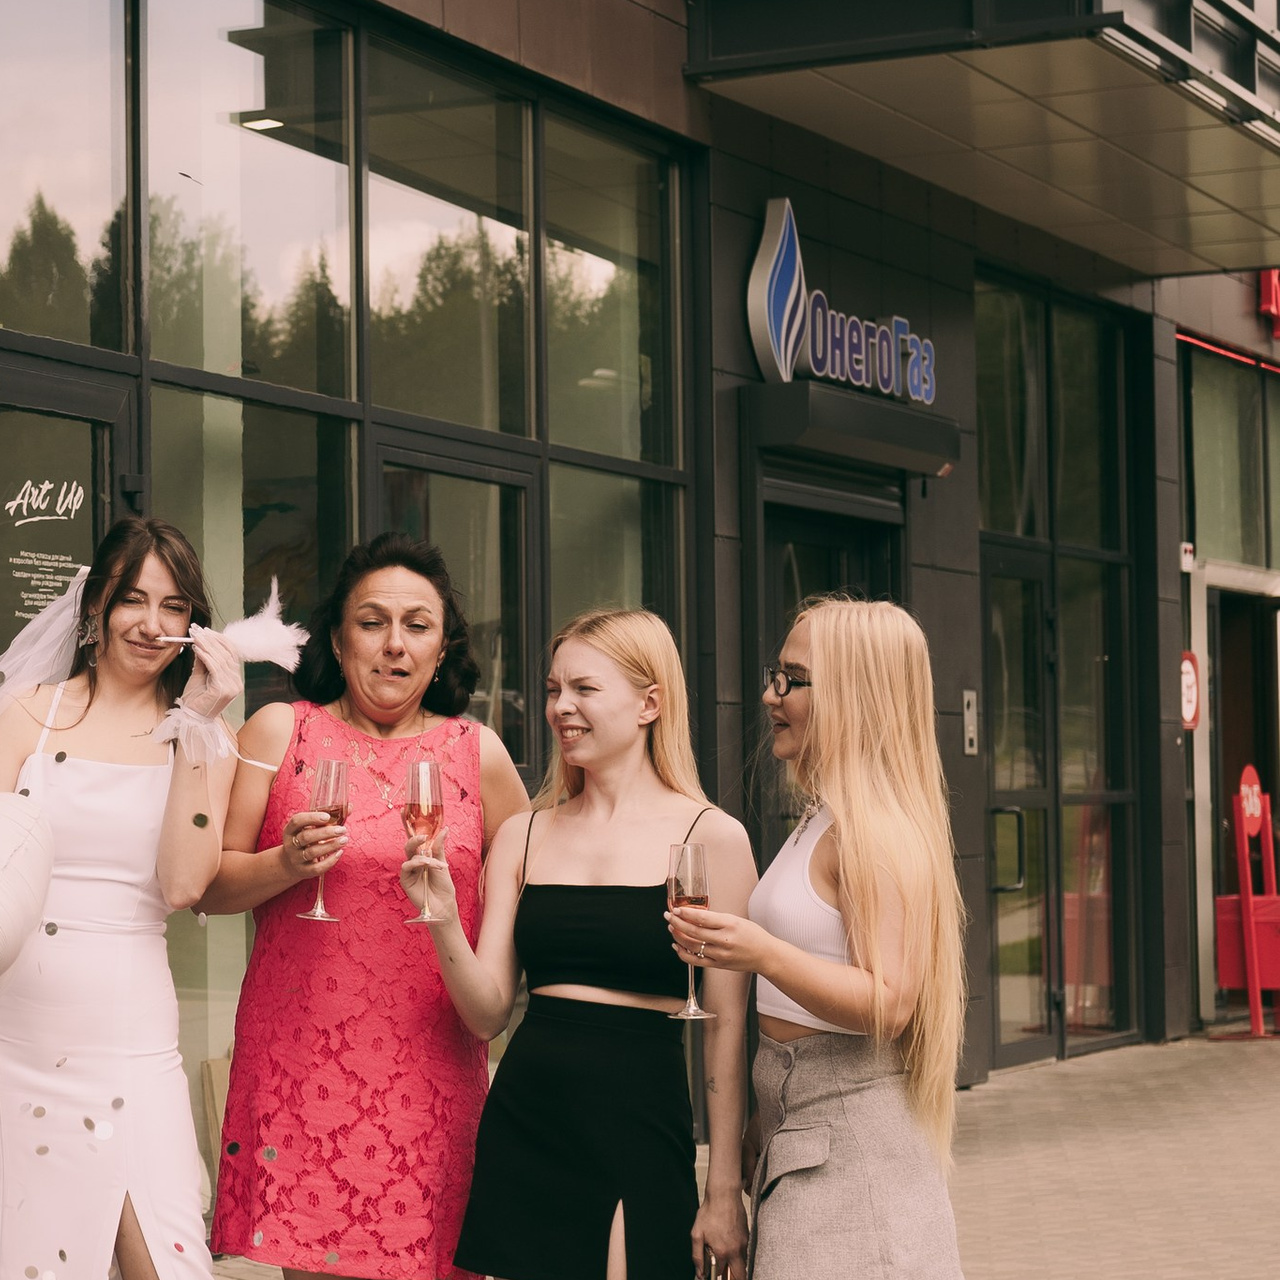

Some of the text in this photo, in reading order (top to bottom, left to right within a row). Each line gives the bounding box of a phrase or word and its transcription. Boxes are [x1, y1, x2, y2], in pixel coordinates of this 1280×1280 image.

[809, 289, 936, 405] ОнегоГаз
[5, 479, 85, 519] Art Up
